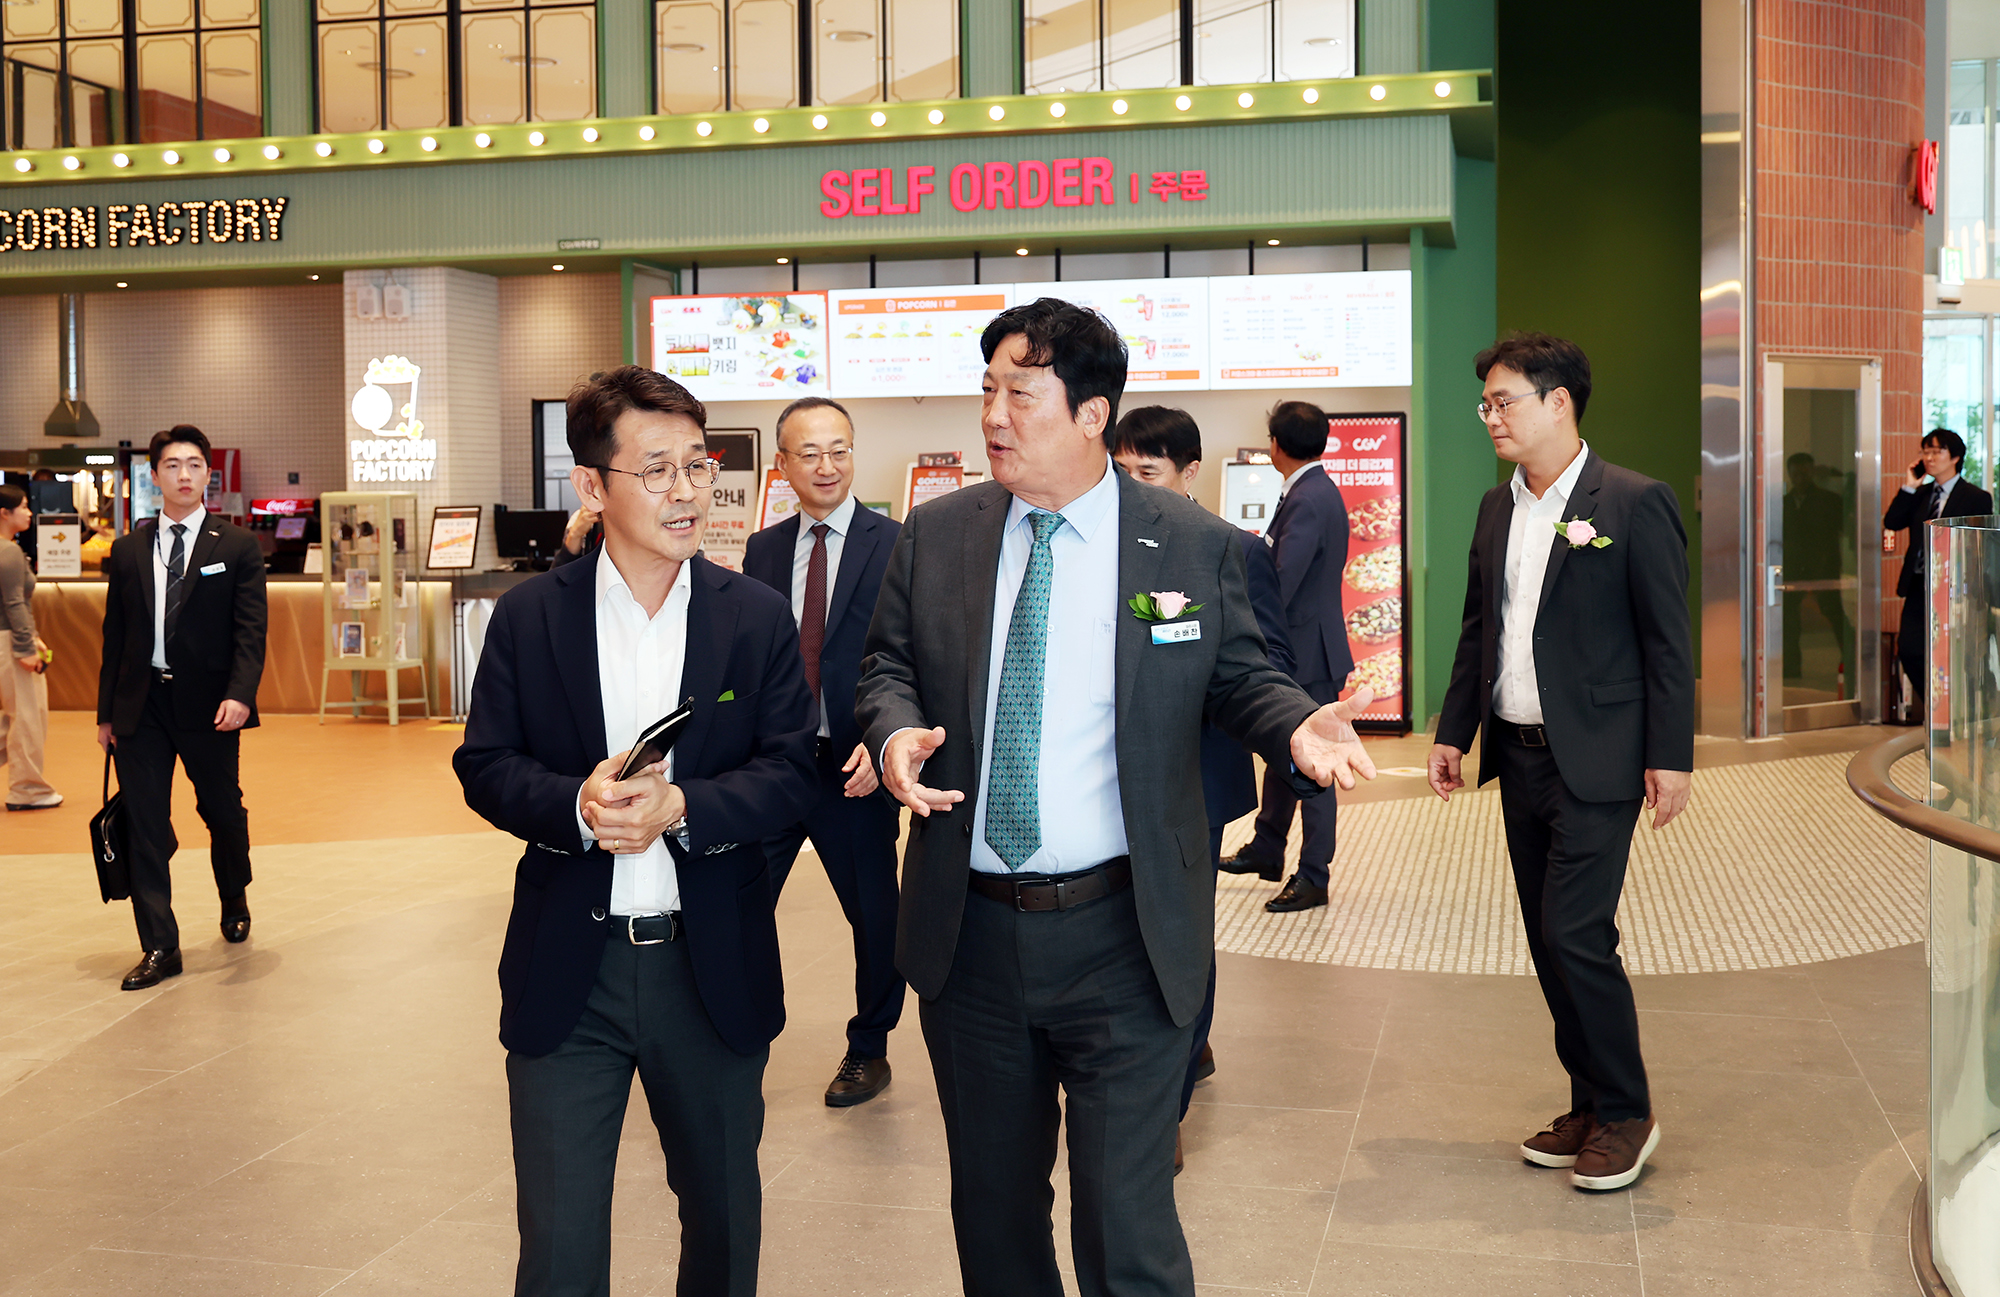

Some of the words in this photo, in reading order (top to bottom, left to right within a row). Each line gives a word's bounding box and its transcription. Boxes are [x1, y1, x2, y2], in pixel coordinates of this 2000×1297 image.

[820, 165, 935, 219] SELF
[950, 156, 1114, 213] ORDER
[1149, 169, 1210, 203] 주문
[108, 196, 288, 248] FACTORY
[897, 299, 938, 310] POPCORN
[712, 336, 736, 350] 뱃지
[713, 359, 737, 373] 키링
[351, 438, 437, 461] POPCORN
[1352, 434, 1387, 452] CGV
[352, 459, 435, 482] FACTORY
[1347, 458, 1358, 471] 더
[916, 476, 958, 486] GOPIZZA
[1342, 473, 1354, 486] 더
[713, 488, 746, 508] 안내
[731, 520, 745, 529] 무료
